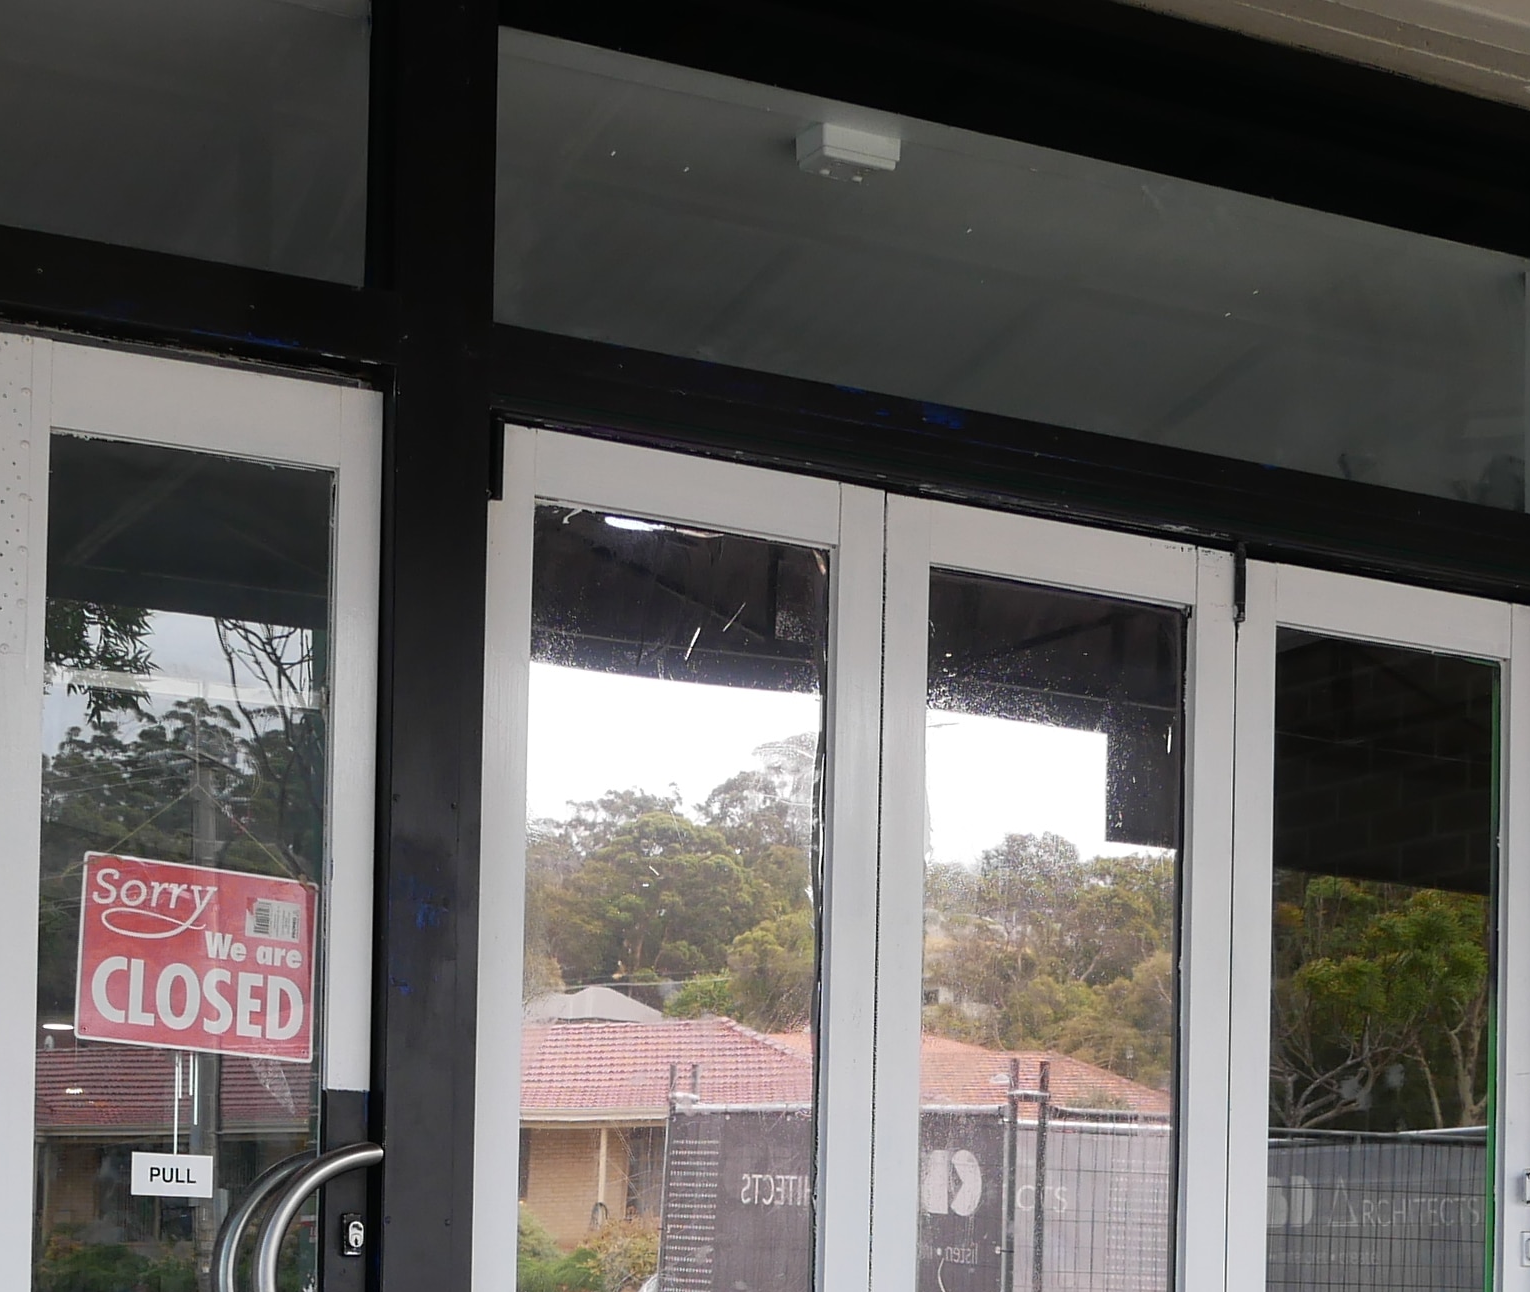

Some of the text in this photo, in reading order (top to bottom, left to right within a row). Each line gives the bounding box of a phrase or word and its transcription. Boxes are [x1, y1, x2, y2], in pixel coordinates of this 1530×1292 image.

[92, 868, 218, 939] Sorry
[204, 931, 303, 969] We are
[91, 955, 304, 1041] CLOSED
[149, 1166, 197, 1184] PULL
